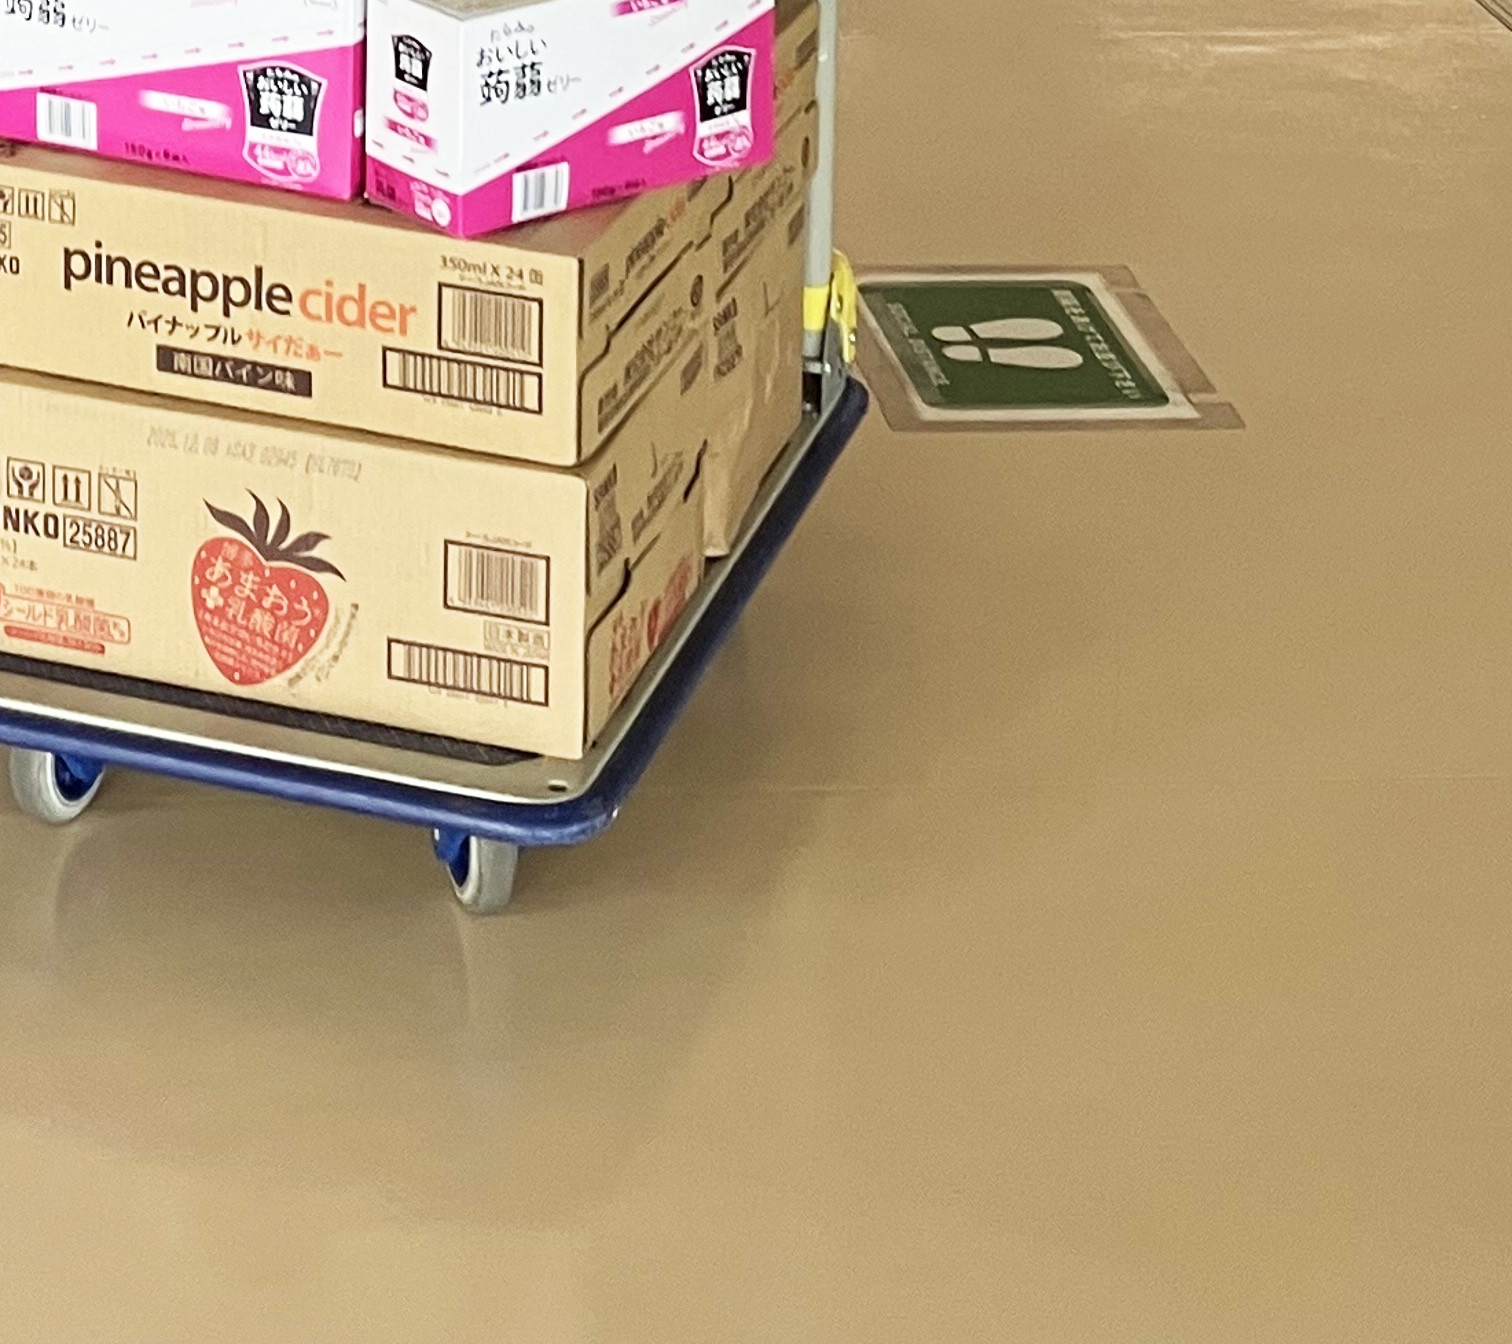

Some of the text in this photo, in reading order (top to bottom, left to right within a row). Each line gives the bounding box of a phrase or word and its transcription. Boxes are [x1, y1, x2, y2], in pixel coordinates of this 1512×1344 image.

[63, 240, 418, 337] pineapple cider
[173, 350, 296, 392] 南国パイン味
[67, 520, 131, 554] 25887
